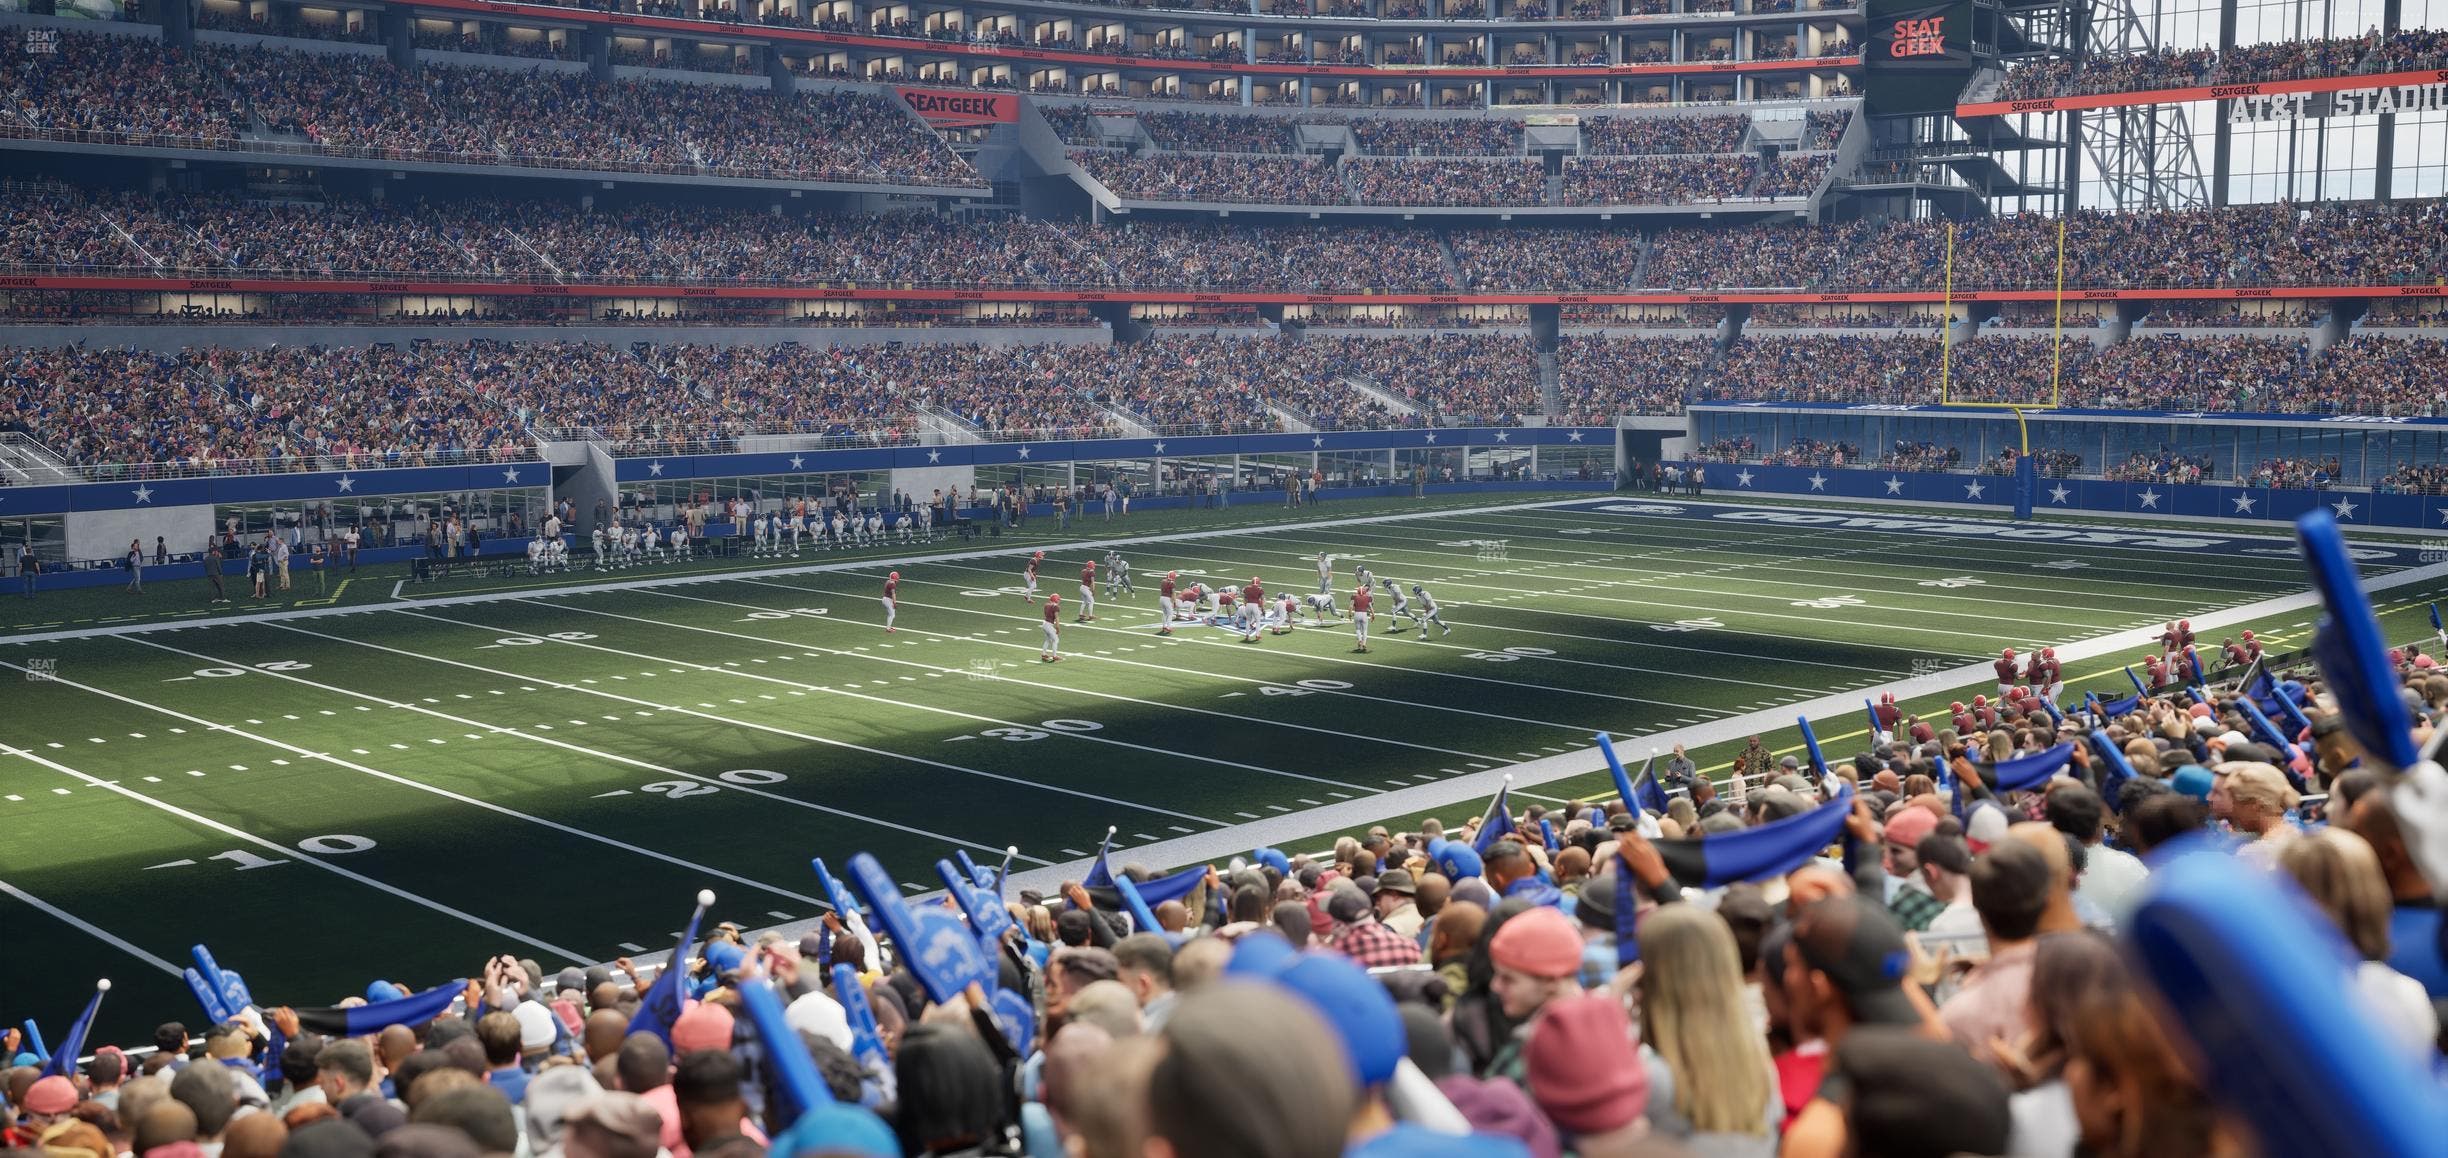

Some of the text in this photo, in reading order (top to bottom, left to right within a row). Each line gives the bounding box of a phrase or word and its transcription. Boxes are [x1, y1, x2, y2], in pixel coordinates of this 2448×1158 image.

[1894, 16, 1945, 39] SEAT
[1890, 36, 1945, 58] GEEK
[2211, 84, 2259, 96] SEATGEEK
[904, 92, 998, 117] SEATGEEK
[2011, 101, 2055, 112] SEATGEEK
[2228, 91, 2313, 123] AT&T
[0, 278, 37, 286] ATGEEK
[190, 281, 232, 289] SEATGEEK
[1713, 512, 2230, 547] COWBOYS
[1648, 619, 1724, 632] 40
[495, 631, 598, 645] 30
[1461, 646, 1557, 662] 50
[193, 660, 312, 677] 20
[1258, 679, 1354, 697] 40
[978, 718, 1104, 741] 30
[640, 769, 788, 799] 20
[208, 833, 377, 871] 10
